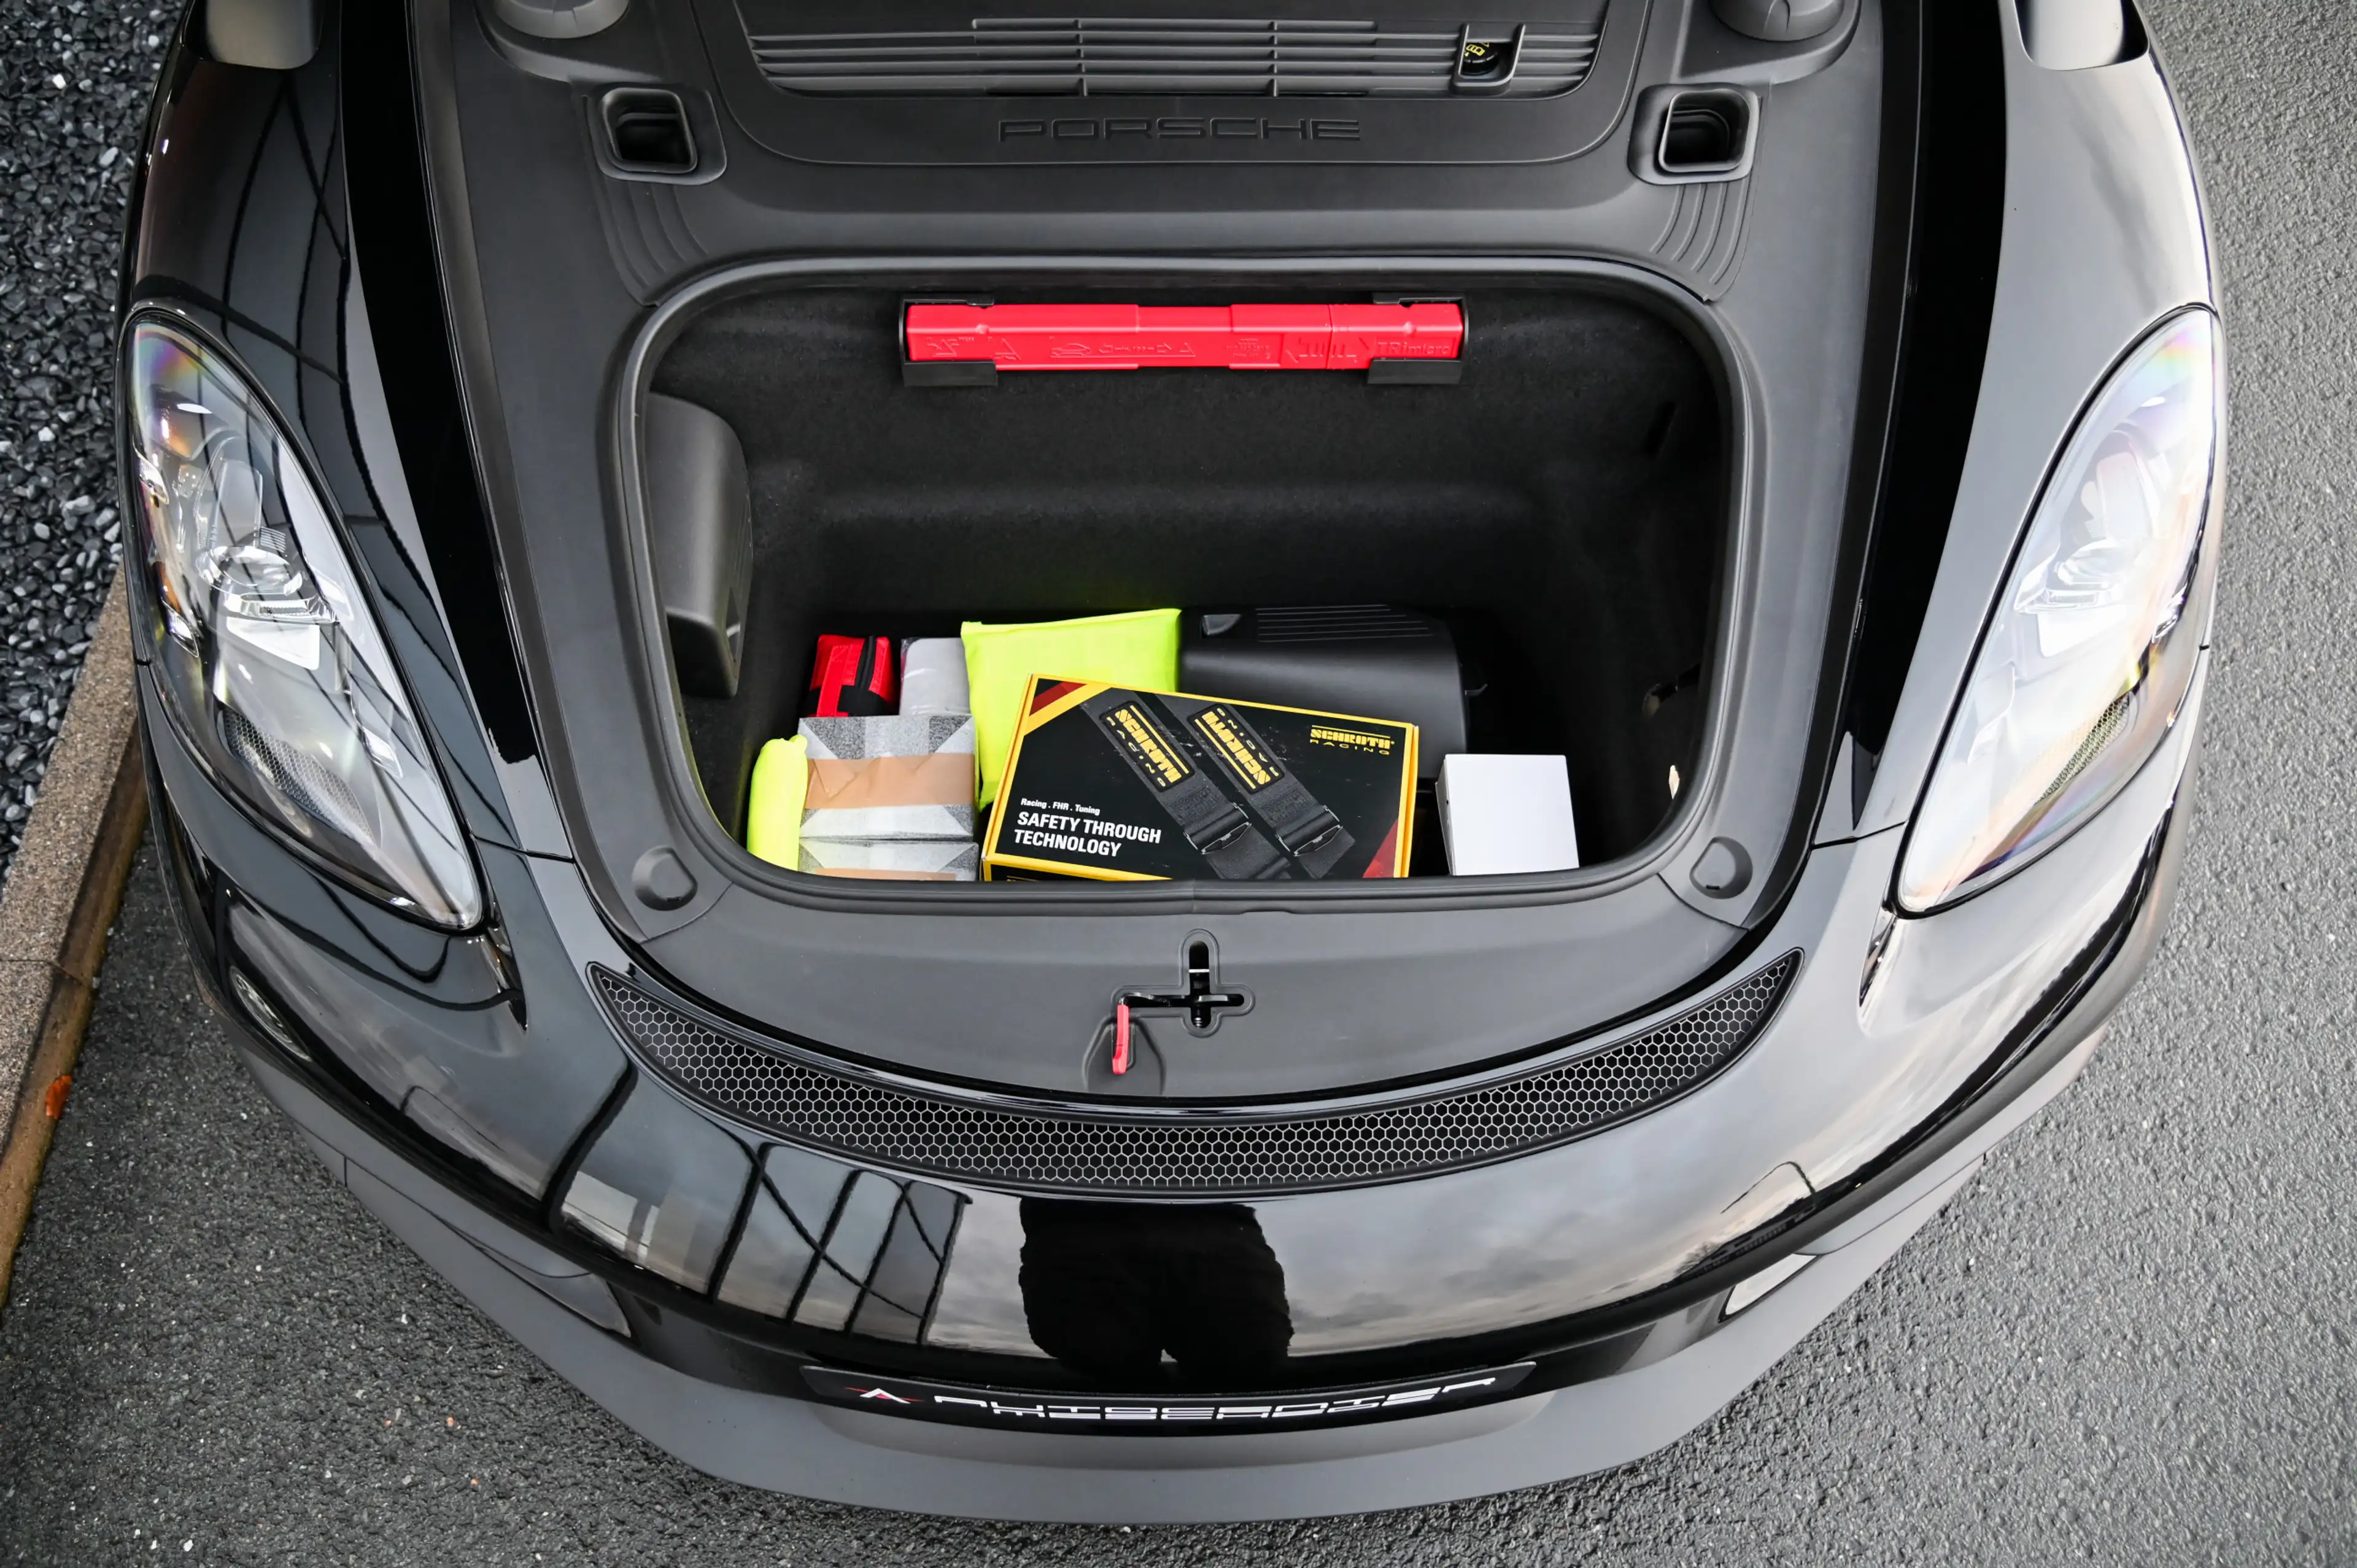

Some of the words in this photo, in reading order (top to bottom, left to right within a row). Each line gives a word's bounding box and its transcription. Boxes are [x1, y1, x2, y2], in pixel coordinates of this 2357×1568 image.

[997, 117, 1361, 141] PORSCHE
[1106, 716, 1166, 787] RACING
[1115, 709, 1182, 783] SCHROTH
[1201, 711, 1271, 785] SCHROTH
[1309, 738, 1390, 755] RACING
[1021, 798, 1047, 809] Racing
[1053, 801, 1069, 811] FHR
[1075, 804, 1101, 816] Tuning
[1014, 828, 1122, 857] TECHNOLOGY
[1017, 811, 1081, 832] SAFETY
[1083, 819, 1162, 844] THROUGH
